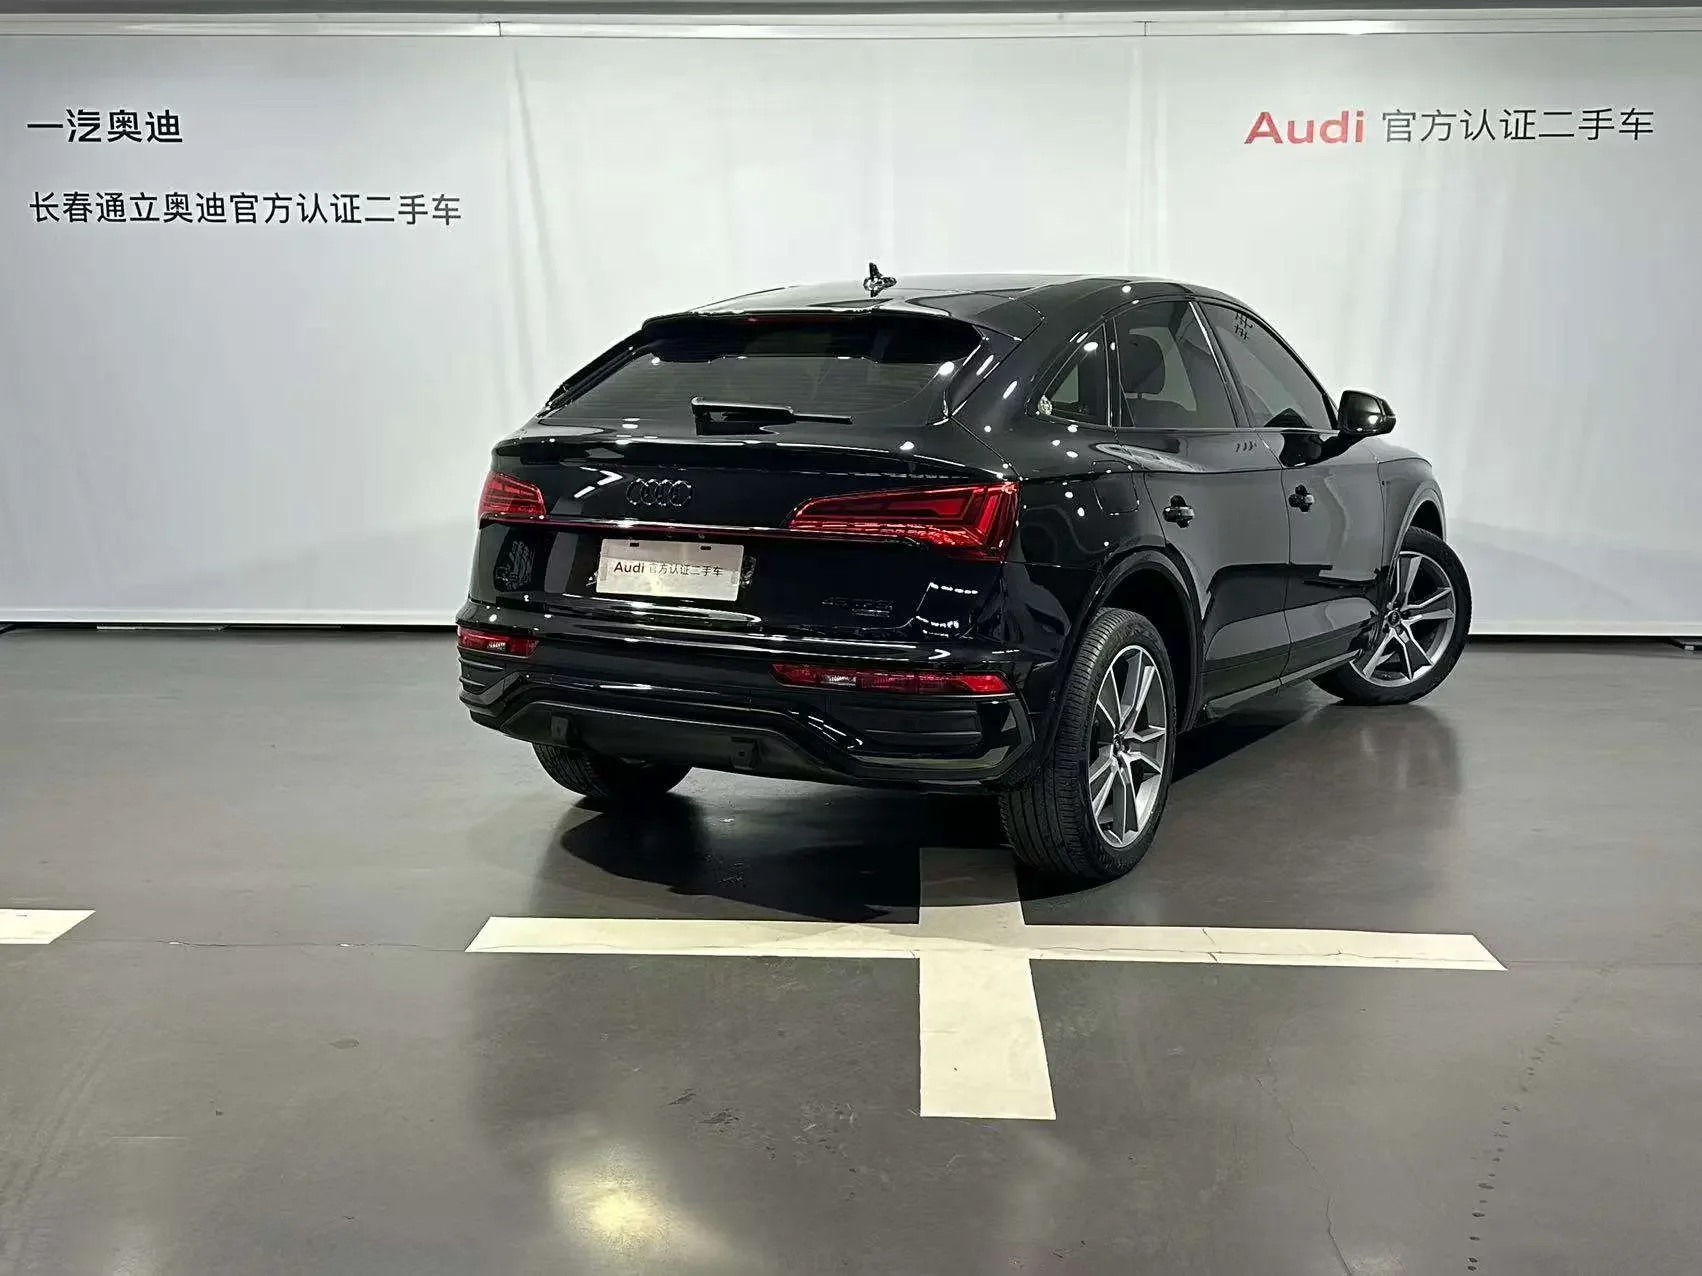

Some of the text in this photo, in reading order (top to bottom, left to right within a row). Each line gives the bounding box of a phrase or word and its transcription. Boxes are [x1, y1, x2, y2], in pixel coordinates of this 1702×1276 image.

[27, 108, 183, 143] 一汽奥迪
[1244, 108, 1654, 145] Audi 官方认证二手车
[29, 191, 462, 226] 长春通立奥迪官方认证二手车
[613, 561, 724, 577] Audi 官方认证二手车
